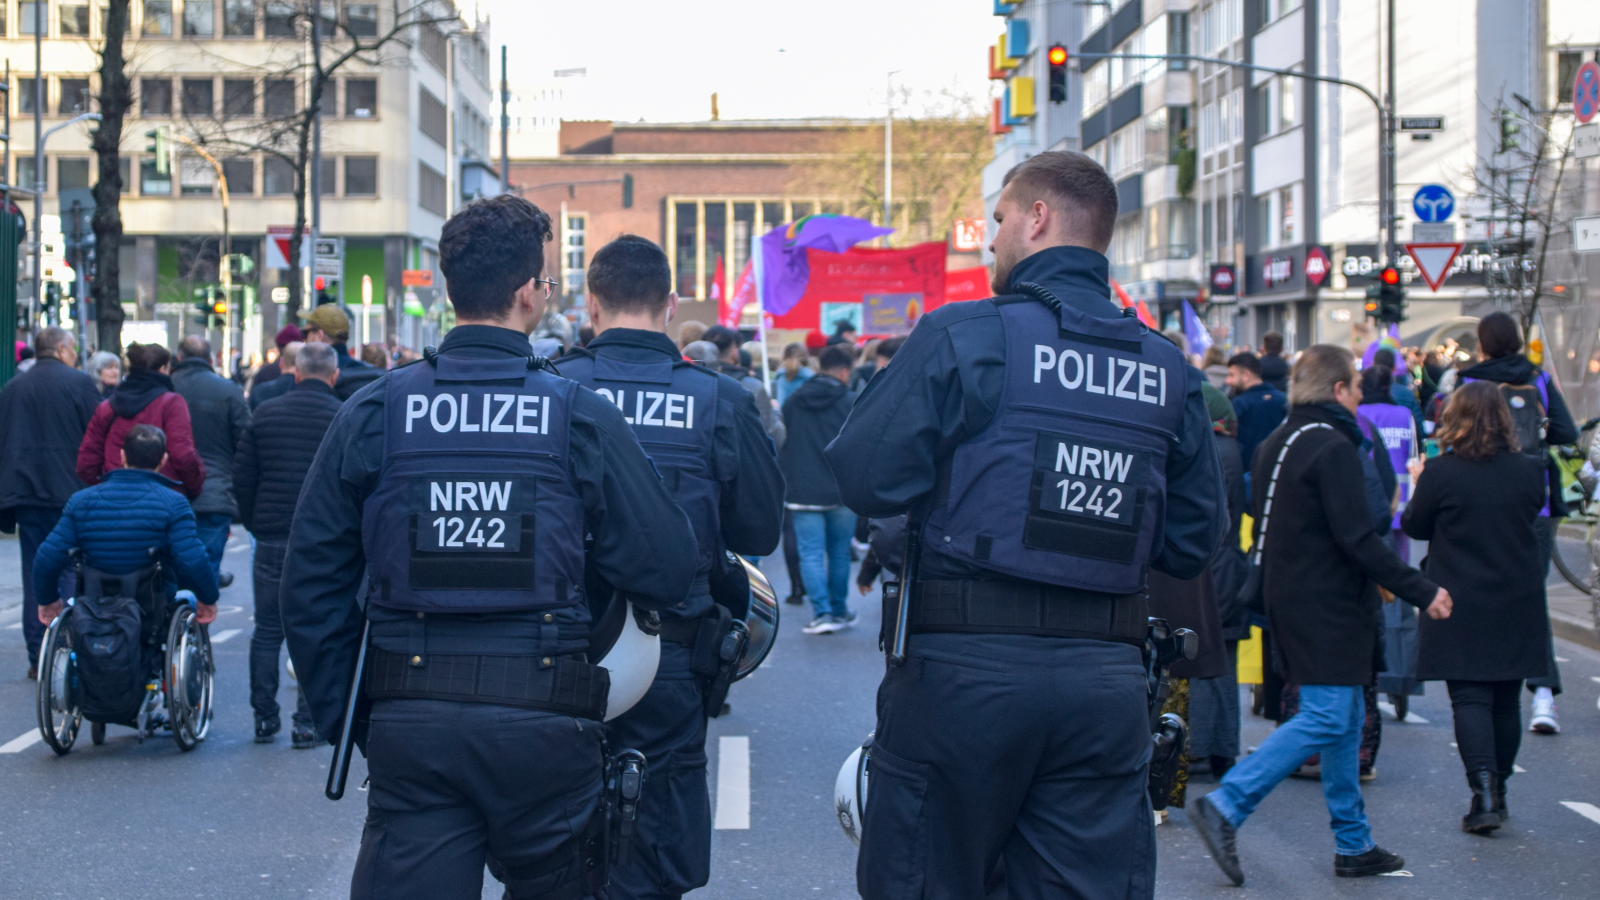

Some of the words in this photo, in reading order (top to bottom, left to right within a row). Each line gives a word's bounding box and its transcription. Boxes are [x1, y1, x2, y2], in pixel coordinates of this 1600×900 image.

[1034, 344, 1166, 407] POLIZEI
[405, 393, 550, 435] POLIZEI
[595, 388, 694, 429] LIZEI
[1055, 442, 1134, 483] NRW
[430, 481, 512, 511] NRW
[1056, 479, 1123, 519] 1242
[432, 517, 506, 548] 1242
